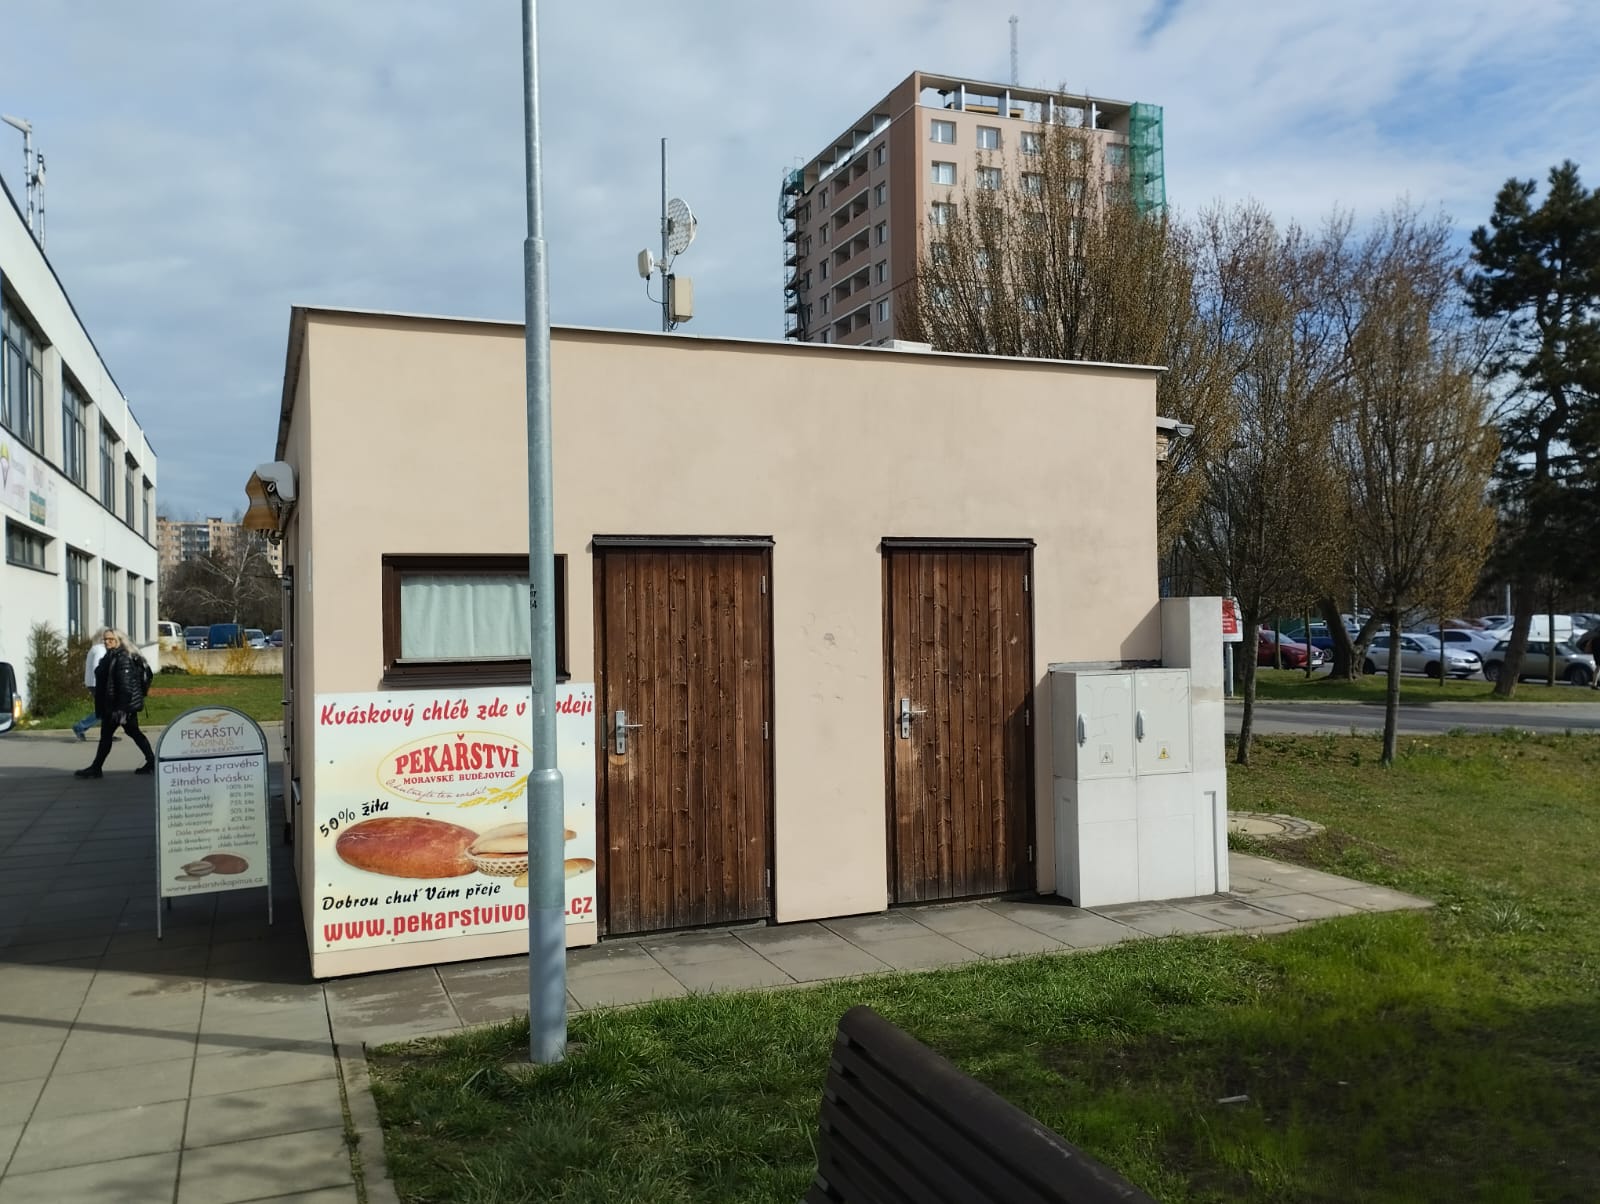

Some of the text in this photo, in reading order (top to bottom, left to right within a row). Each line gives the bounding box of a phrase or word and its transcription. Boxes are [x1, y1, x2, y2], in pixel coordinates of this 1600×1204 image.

[320, 694, 592, 727] Kváskový chléb zde v odeji
[181, 723, 244, 740] PEKAŘSTVÍ
[163, 764, 201, 774] Chleby
[215, 758, 260, 772] pravého
[170, 775, 210, 787] žitného
[320, 798, 389, 838] 50% žita
[322, 882, 501, 910] Dobrou chuť Vám přeje
